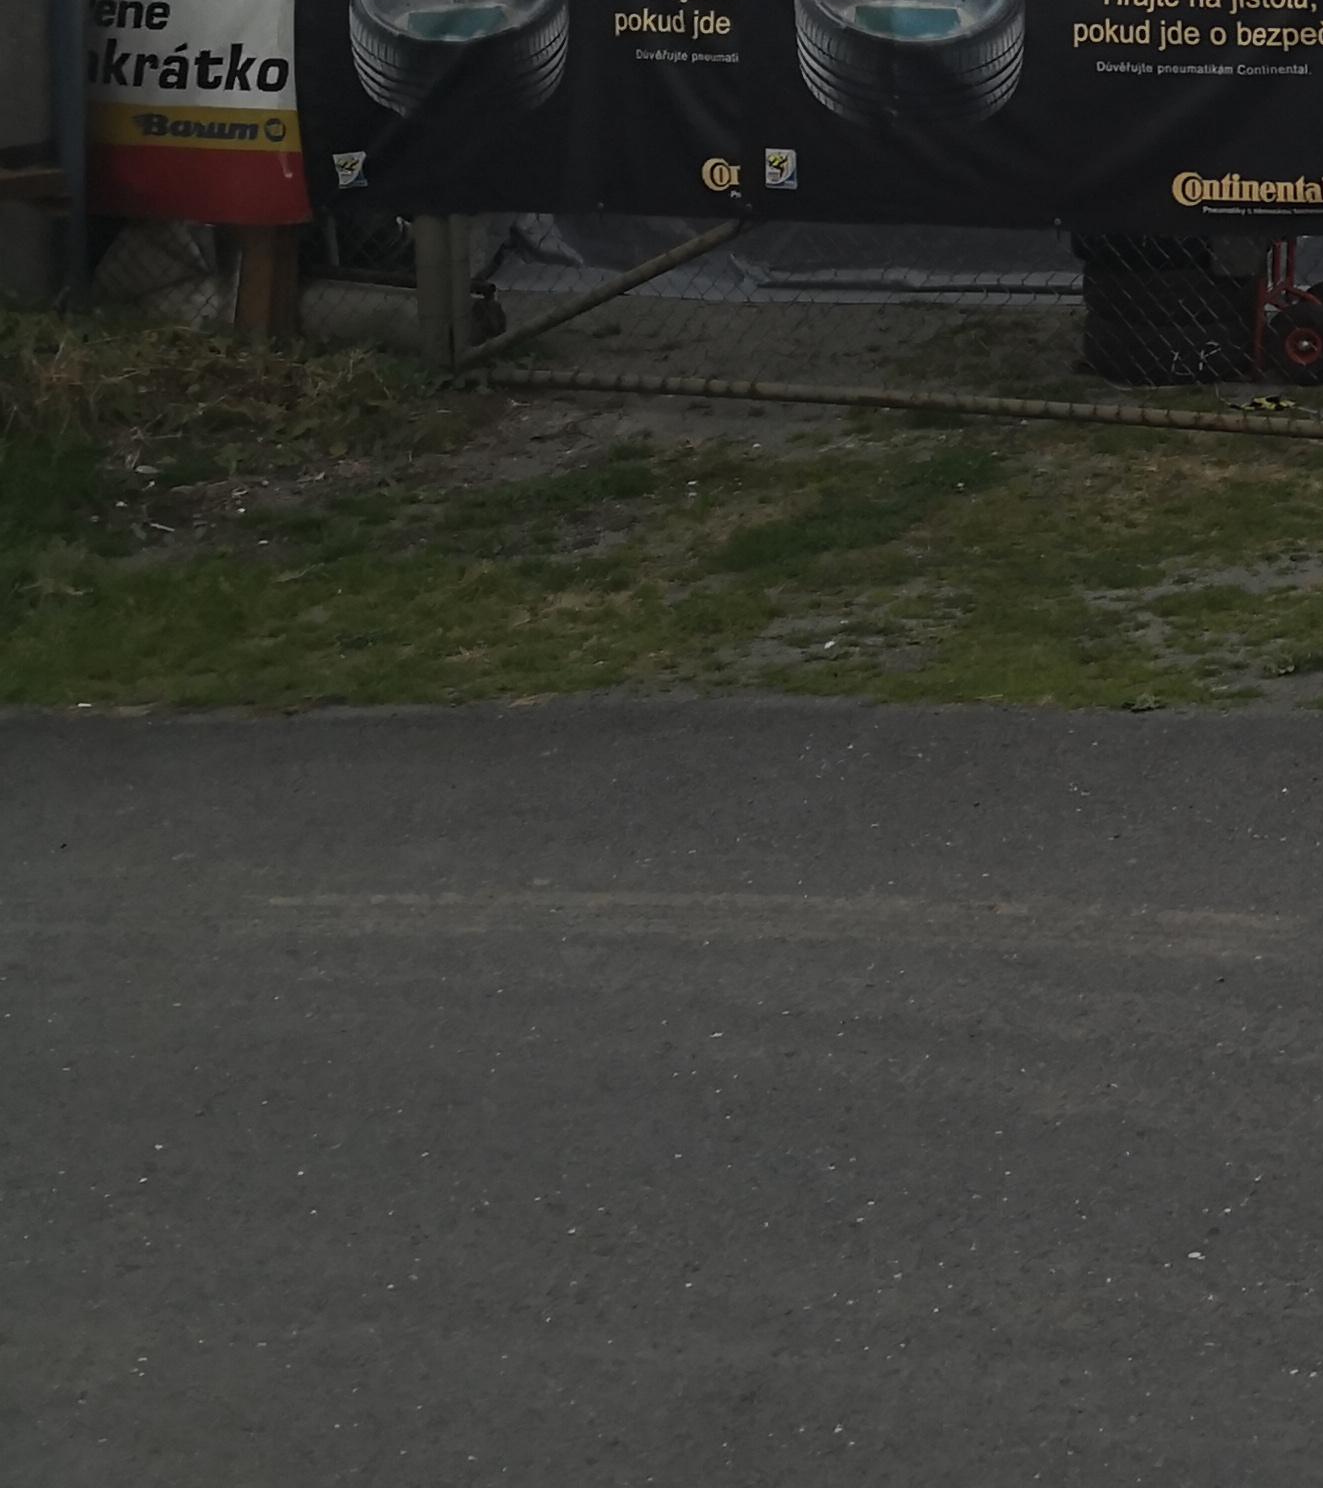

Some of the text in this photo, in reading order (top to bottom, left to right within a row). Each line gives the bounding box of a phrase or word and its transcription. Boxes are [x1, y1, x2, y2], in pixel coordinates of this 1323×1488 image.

[614, 7, 732, 40] pokud jde
[1072, 17, 1151, 48] pokud
[1158, 19, 1201, 52] jde
[1210, 25, 1227, 46] o
[132, 111, 259, 141] Barum
